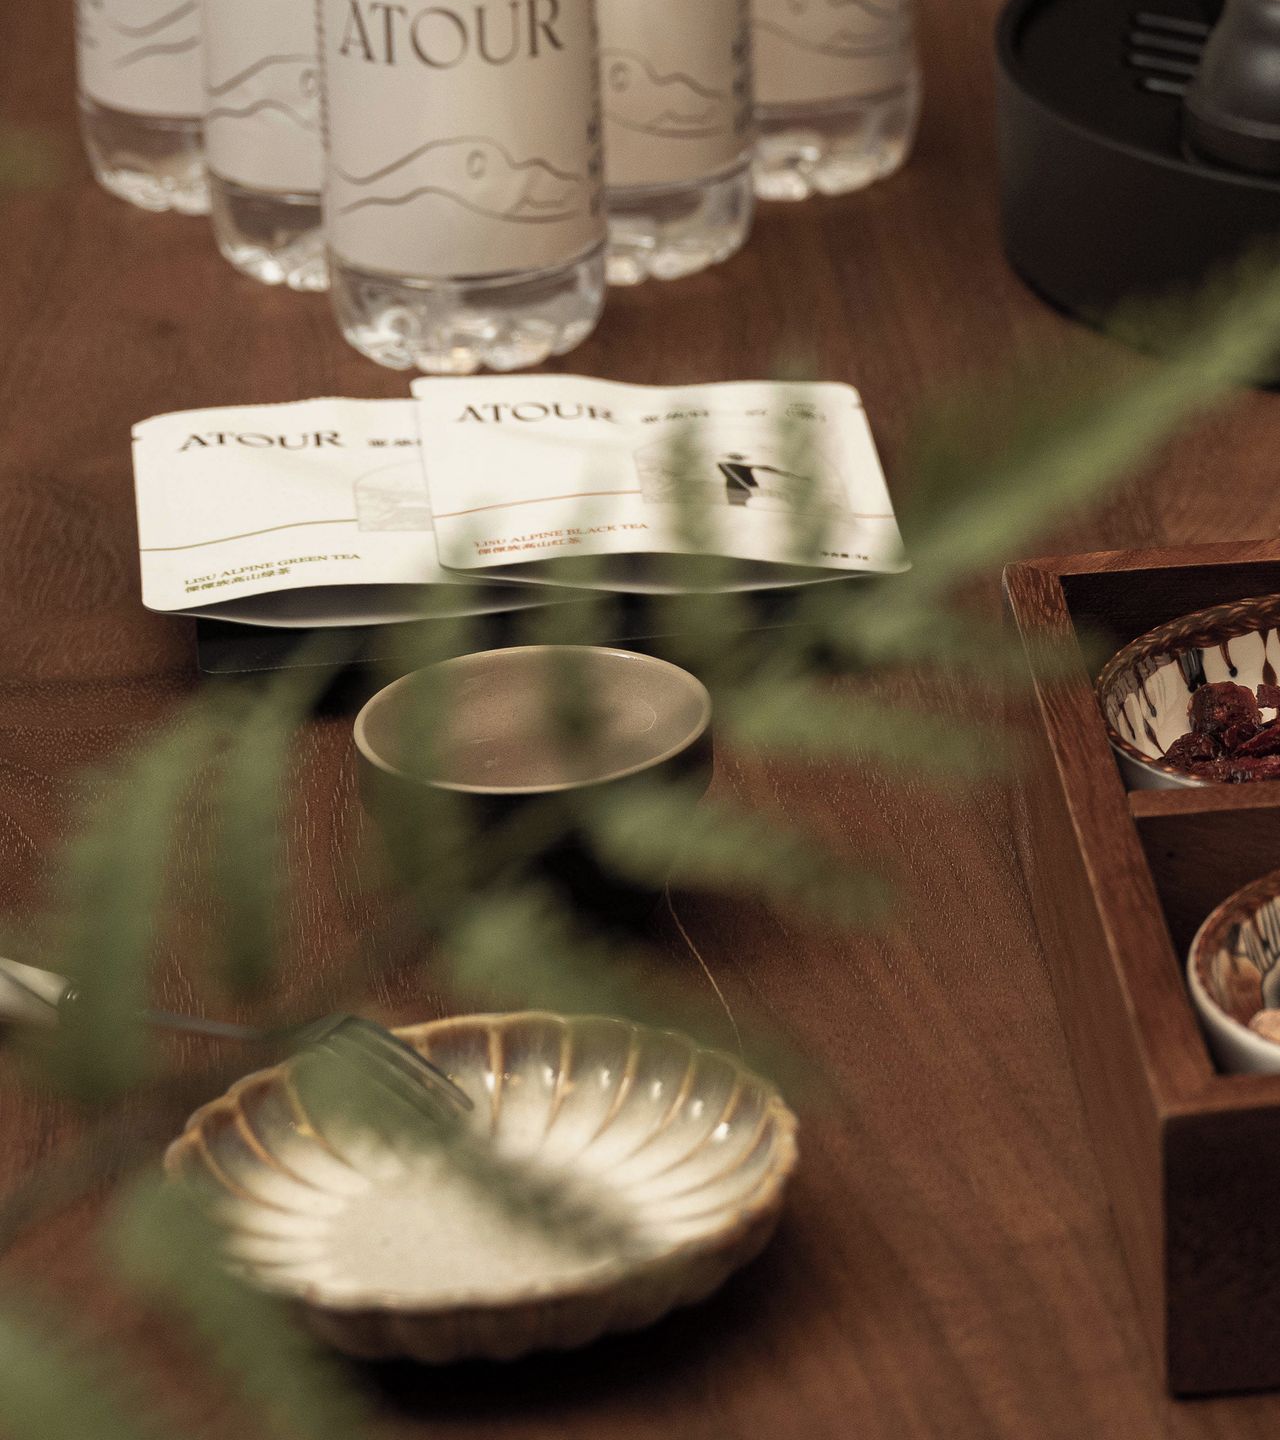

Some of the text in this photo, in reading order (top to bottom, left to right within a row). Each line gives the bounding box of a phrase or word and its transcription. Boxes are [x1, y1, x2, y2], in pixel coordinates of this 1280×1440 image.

[456, 401, 620, 425] ATOUR
[178, 430, 346, 452] ATOUR
[510, 529, 563, 544] ALPINE
[566, 524, 617, 536] BLACK
[621, 522, 650, 530] TEA
[184, 553, 361, 586] LISU ALPINE GREEN TEA
